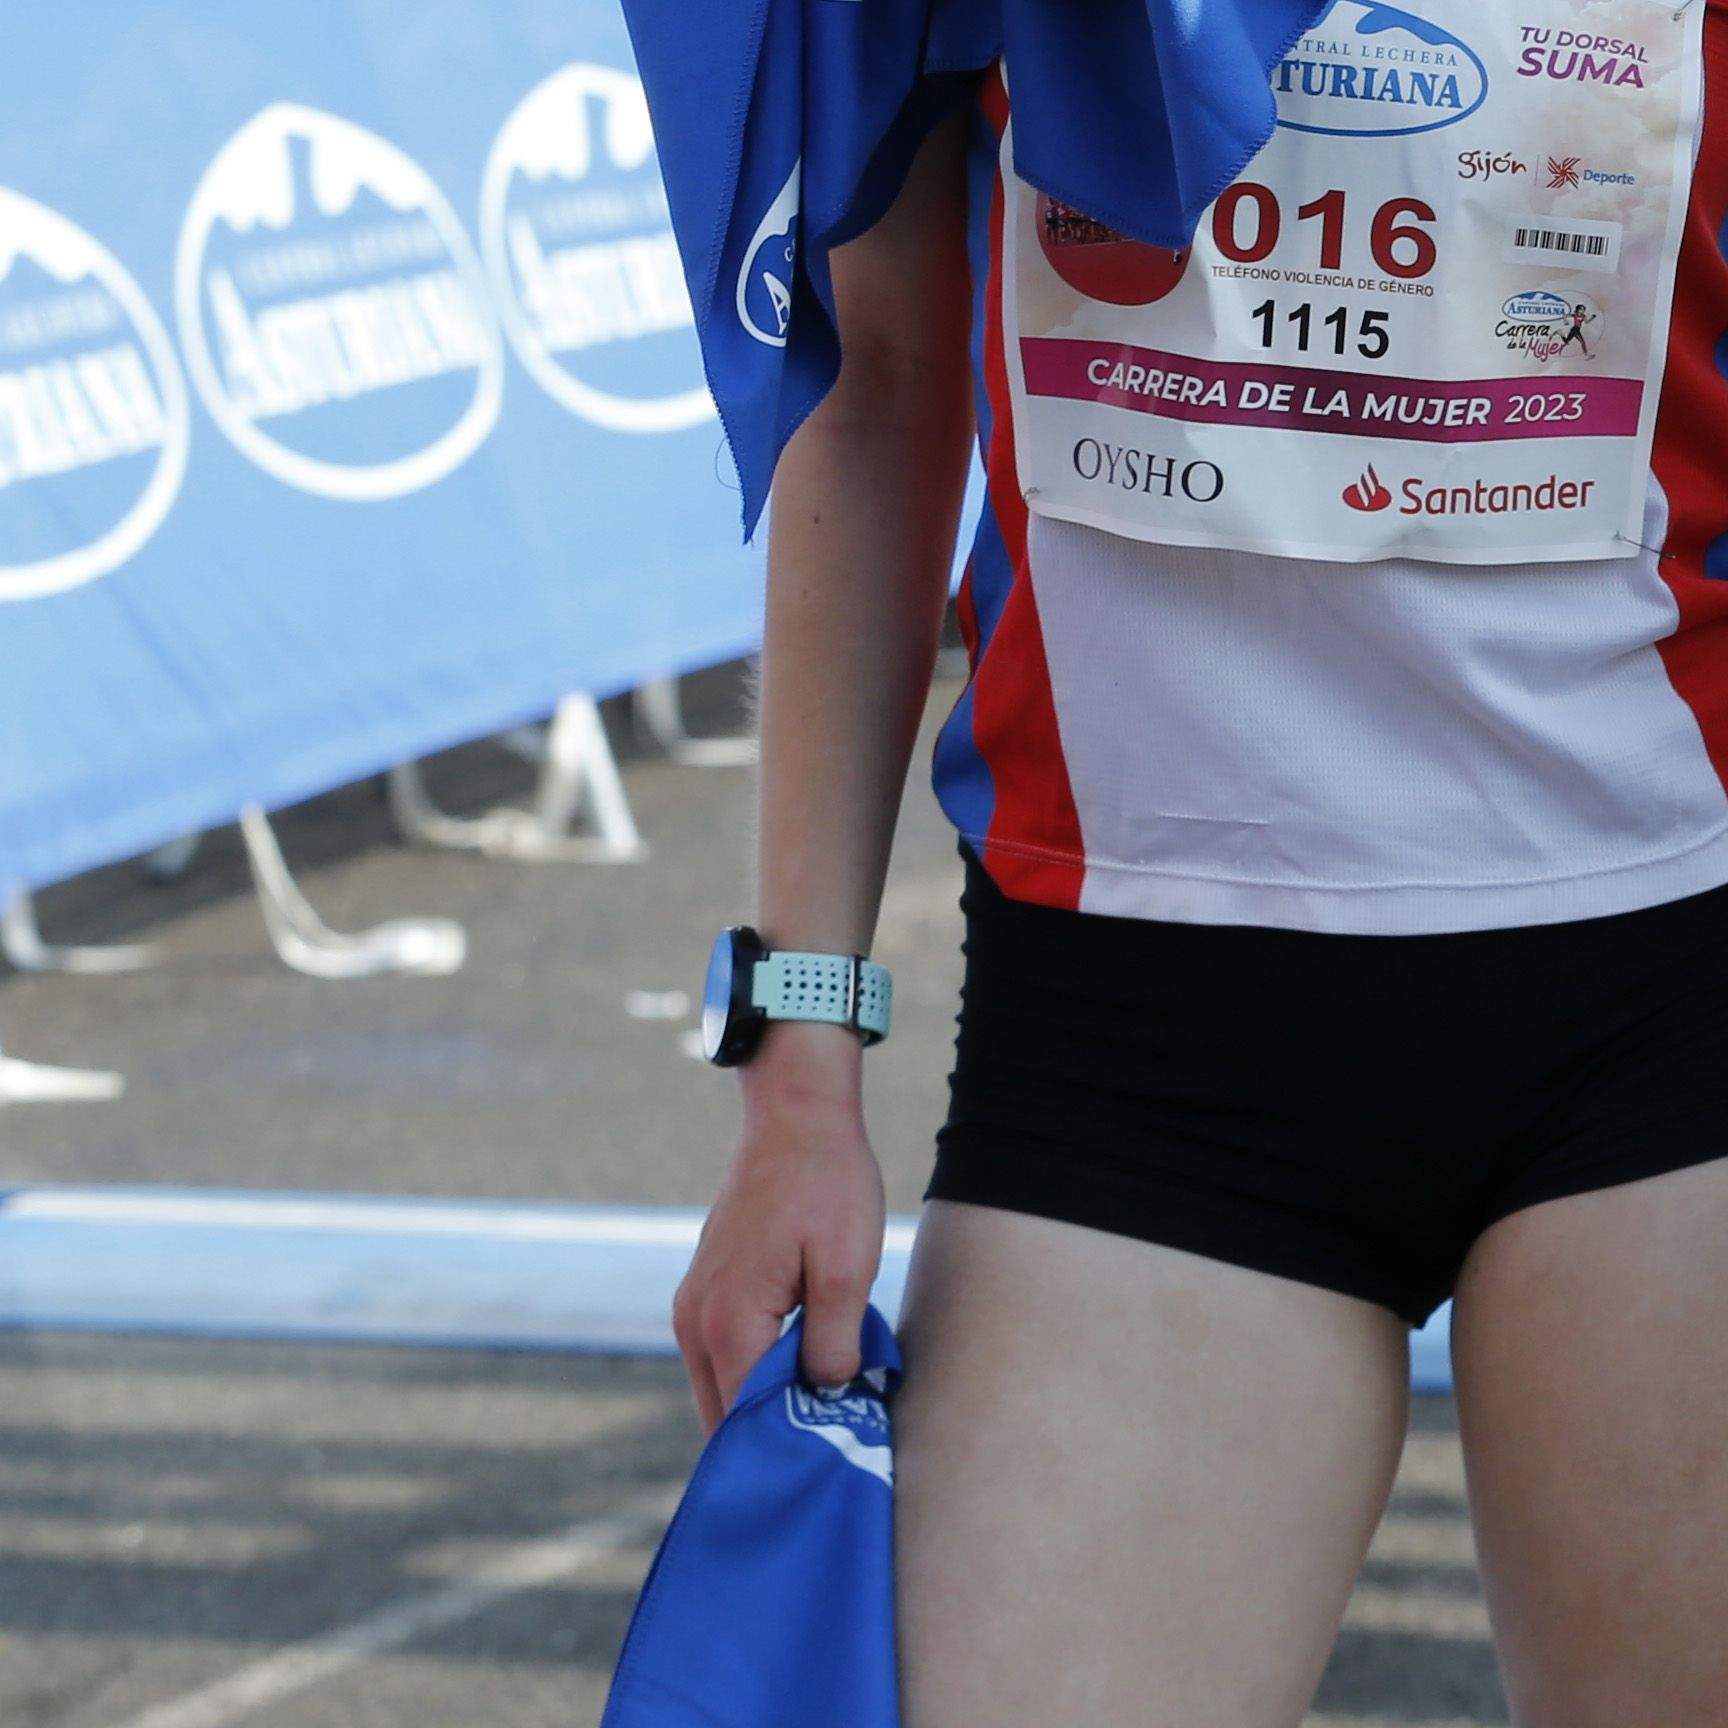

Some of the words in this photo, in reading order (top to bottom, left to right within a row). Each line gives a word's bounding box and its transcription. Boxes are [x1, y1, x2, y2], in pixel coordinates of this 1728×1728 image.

[1362, 45, 1459, 67] LECHERA
[1520, 27, 1551, 44] TU
[1556, 31, 1649, 63] DORSAL
[1516, 47, 1645, 89] SUMA
[1458, 150, 1528, 182] gijón
[1583, 169, 1635, 186] Deporte
[1212, 182, 1437, 279] 016
[1211, 264, 1281, 283] TELÉFONO
[1283, 271, 1355, 290] VIOLENCIA
[1357, 278, 1376, 292] DE
[1379, 277, 1435, 298] GÉNERO
[1251, 299, 1390, 359] 1115
[1495, 320, 1551, 337] Carrera
[1524, 336, 1567, 363] Mujer
[1086, 359, 1228, 408] CARRERA
[1238, 381, 1295, 412] DE
[1302, 386, 1351, 418] LA
[1360, 391, 1491, 427] MUJER
[1503, 393, 1587, 424] 2023
[1072, 437, 1224, 503] OYSHO
[1400, 475, 1595, 516] Santander
